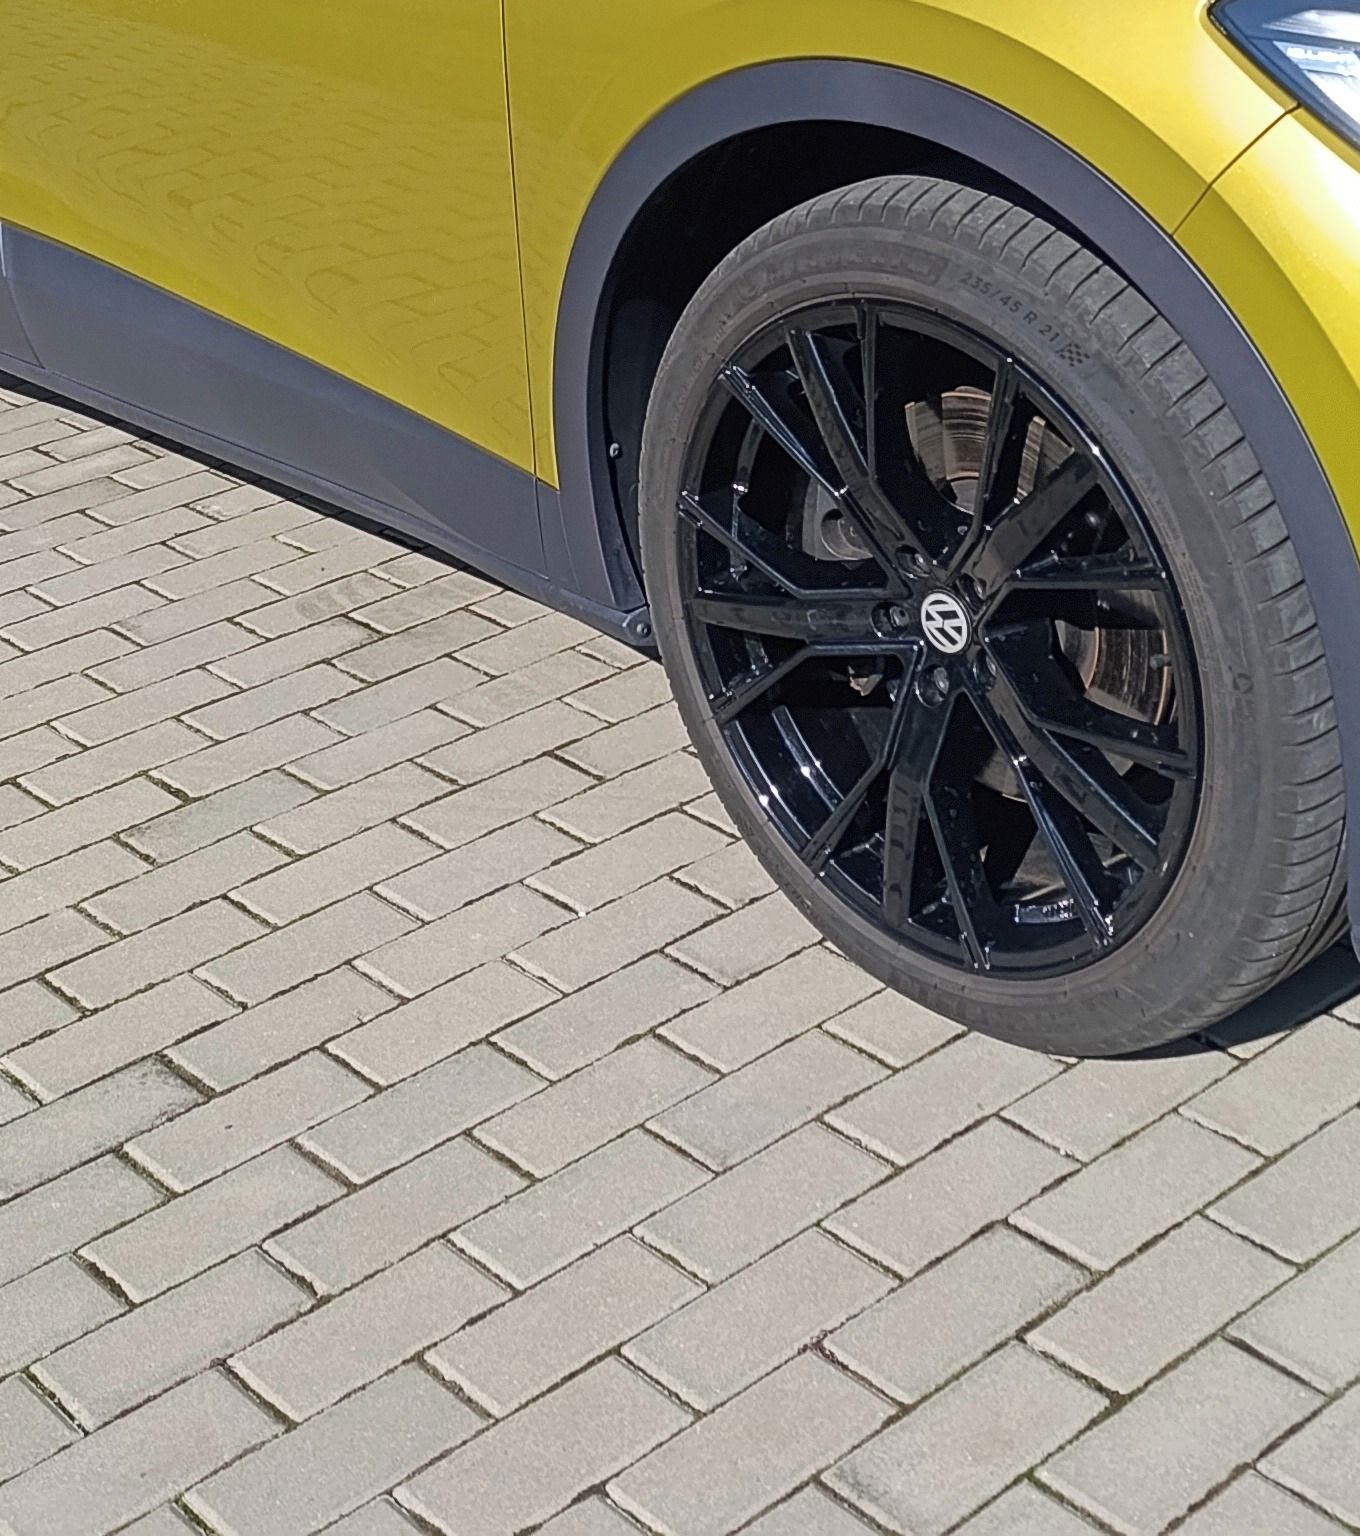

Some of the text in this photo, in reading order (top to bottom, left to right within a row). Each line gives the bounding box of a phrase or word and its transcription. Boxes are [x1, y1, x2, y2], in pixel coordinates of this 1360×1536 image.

[959, 271, 1059, 342] 235/45 R 21
